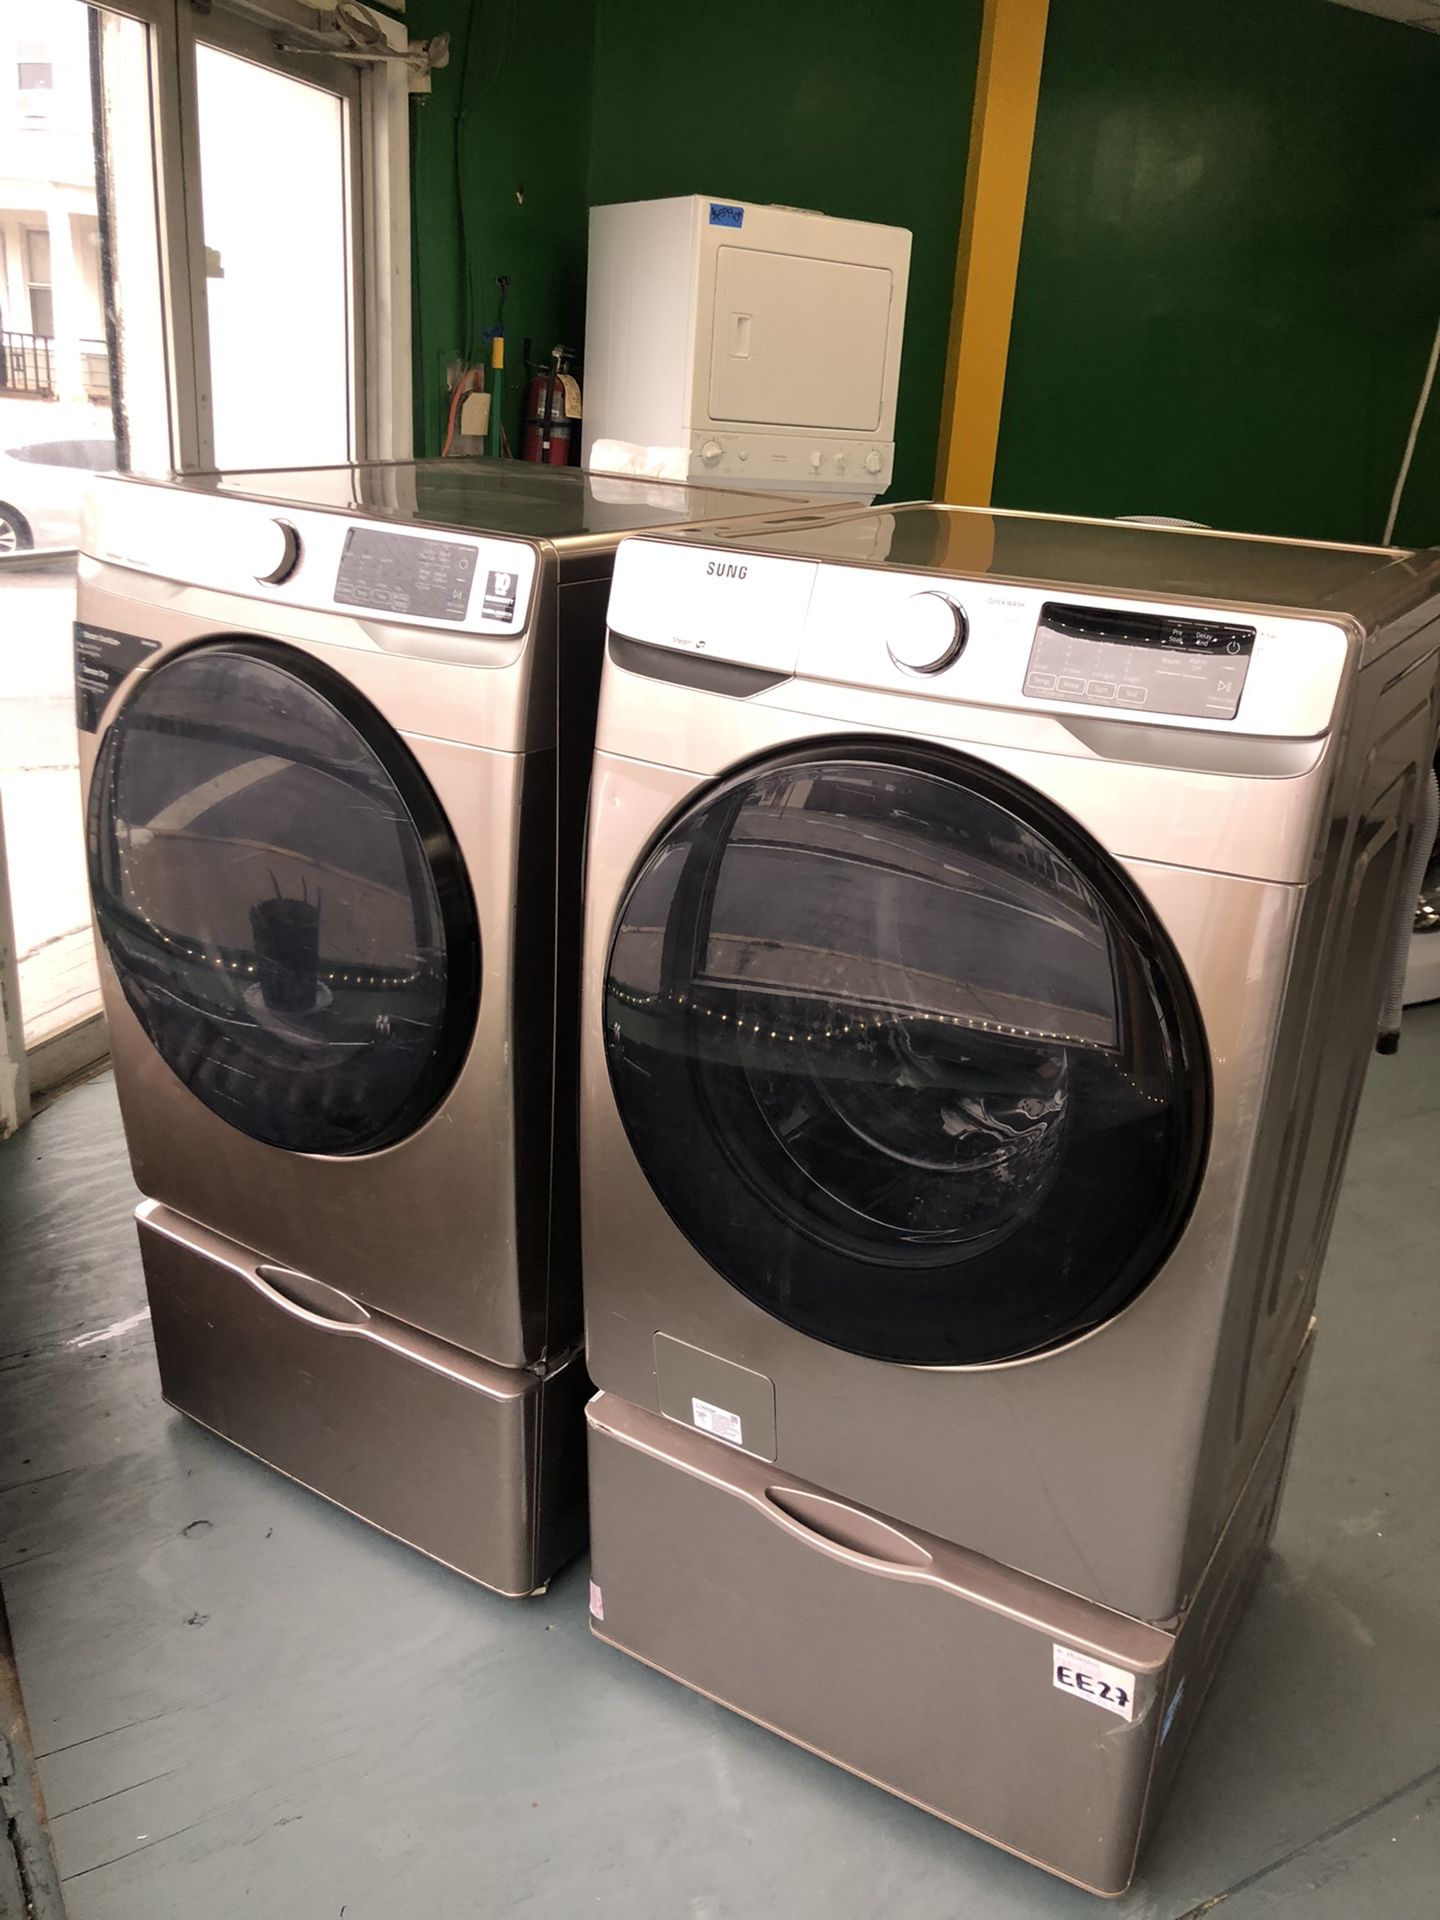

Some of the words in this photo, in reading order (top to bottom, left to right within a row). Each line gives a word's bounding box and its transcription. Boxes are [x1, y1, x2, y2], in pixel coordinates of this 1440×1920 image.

[706, 561, 748, 580] SUNG
[1172, 628, 1183, 636] Pre
[1195, 631, 1213, 642] Delay
[1056, 1665, 1130, 1707] EE27
